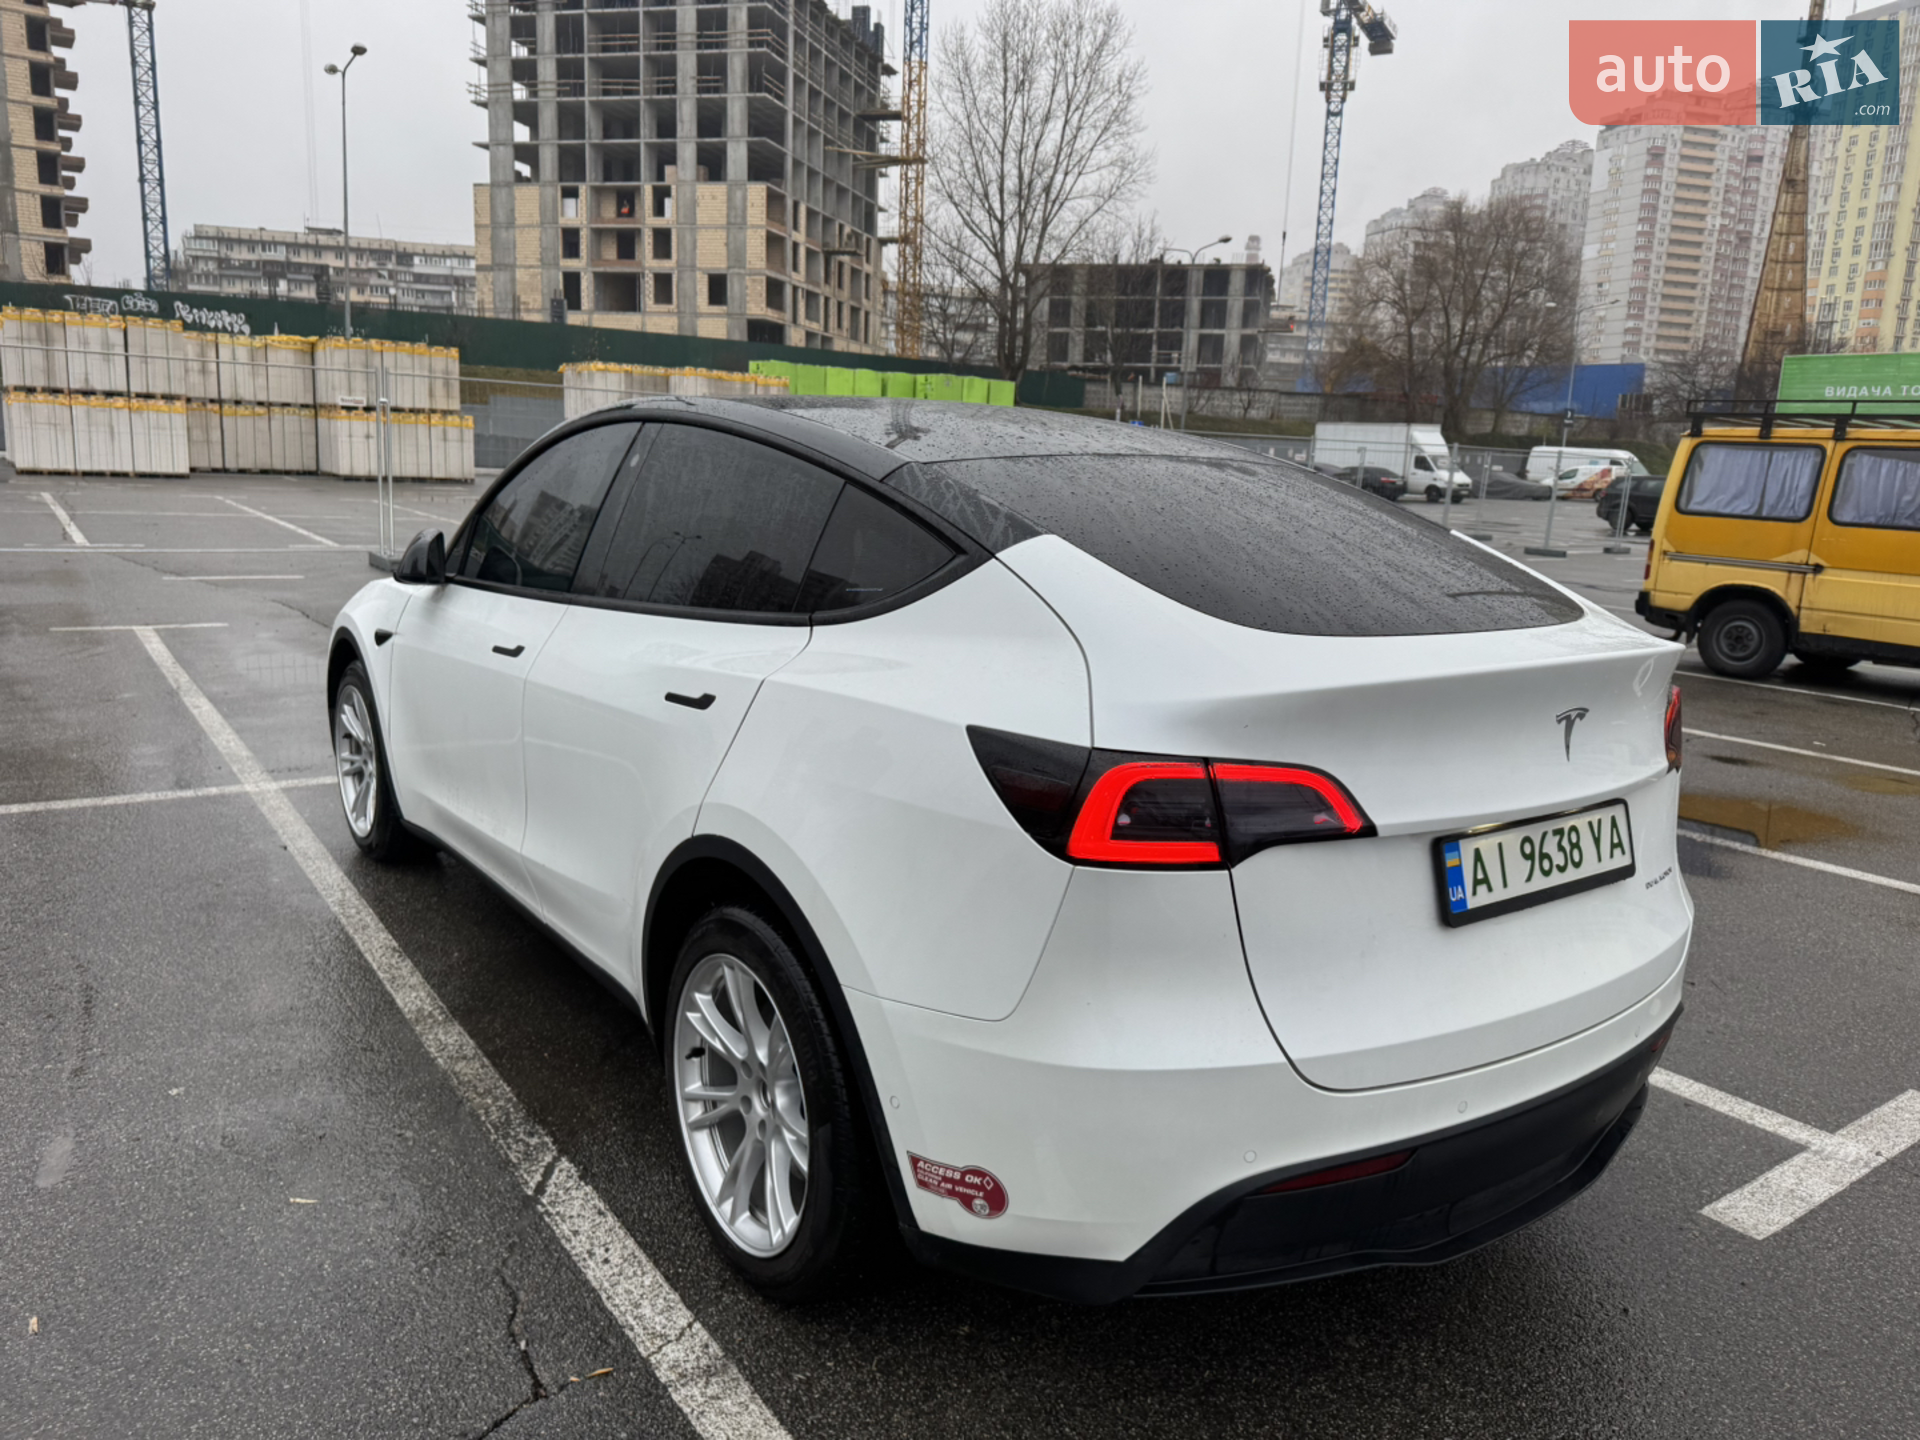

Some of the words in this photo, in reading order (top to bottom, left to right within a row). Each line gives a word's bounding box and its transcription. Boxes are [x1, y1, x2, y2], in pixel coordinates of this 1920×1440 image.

[1825, 385, 1892, 398] ВИДАЧА
[1472, 842, 1508, 896] AI
[1519, 824, 1584, 883] 9638
[1588, 815, 1626, 863] YA
[1449, 887, 1465, 901] UA
[917, 1160, 961, 1180] ACCESS
[965, 1174, 982, 1185] OK
[917, 1174, 938, 1185] CLEAN
[940, 1182, 953, 1190] AIR
[955, 1185, 984, 1197] VEHICLE
